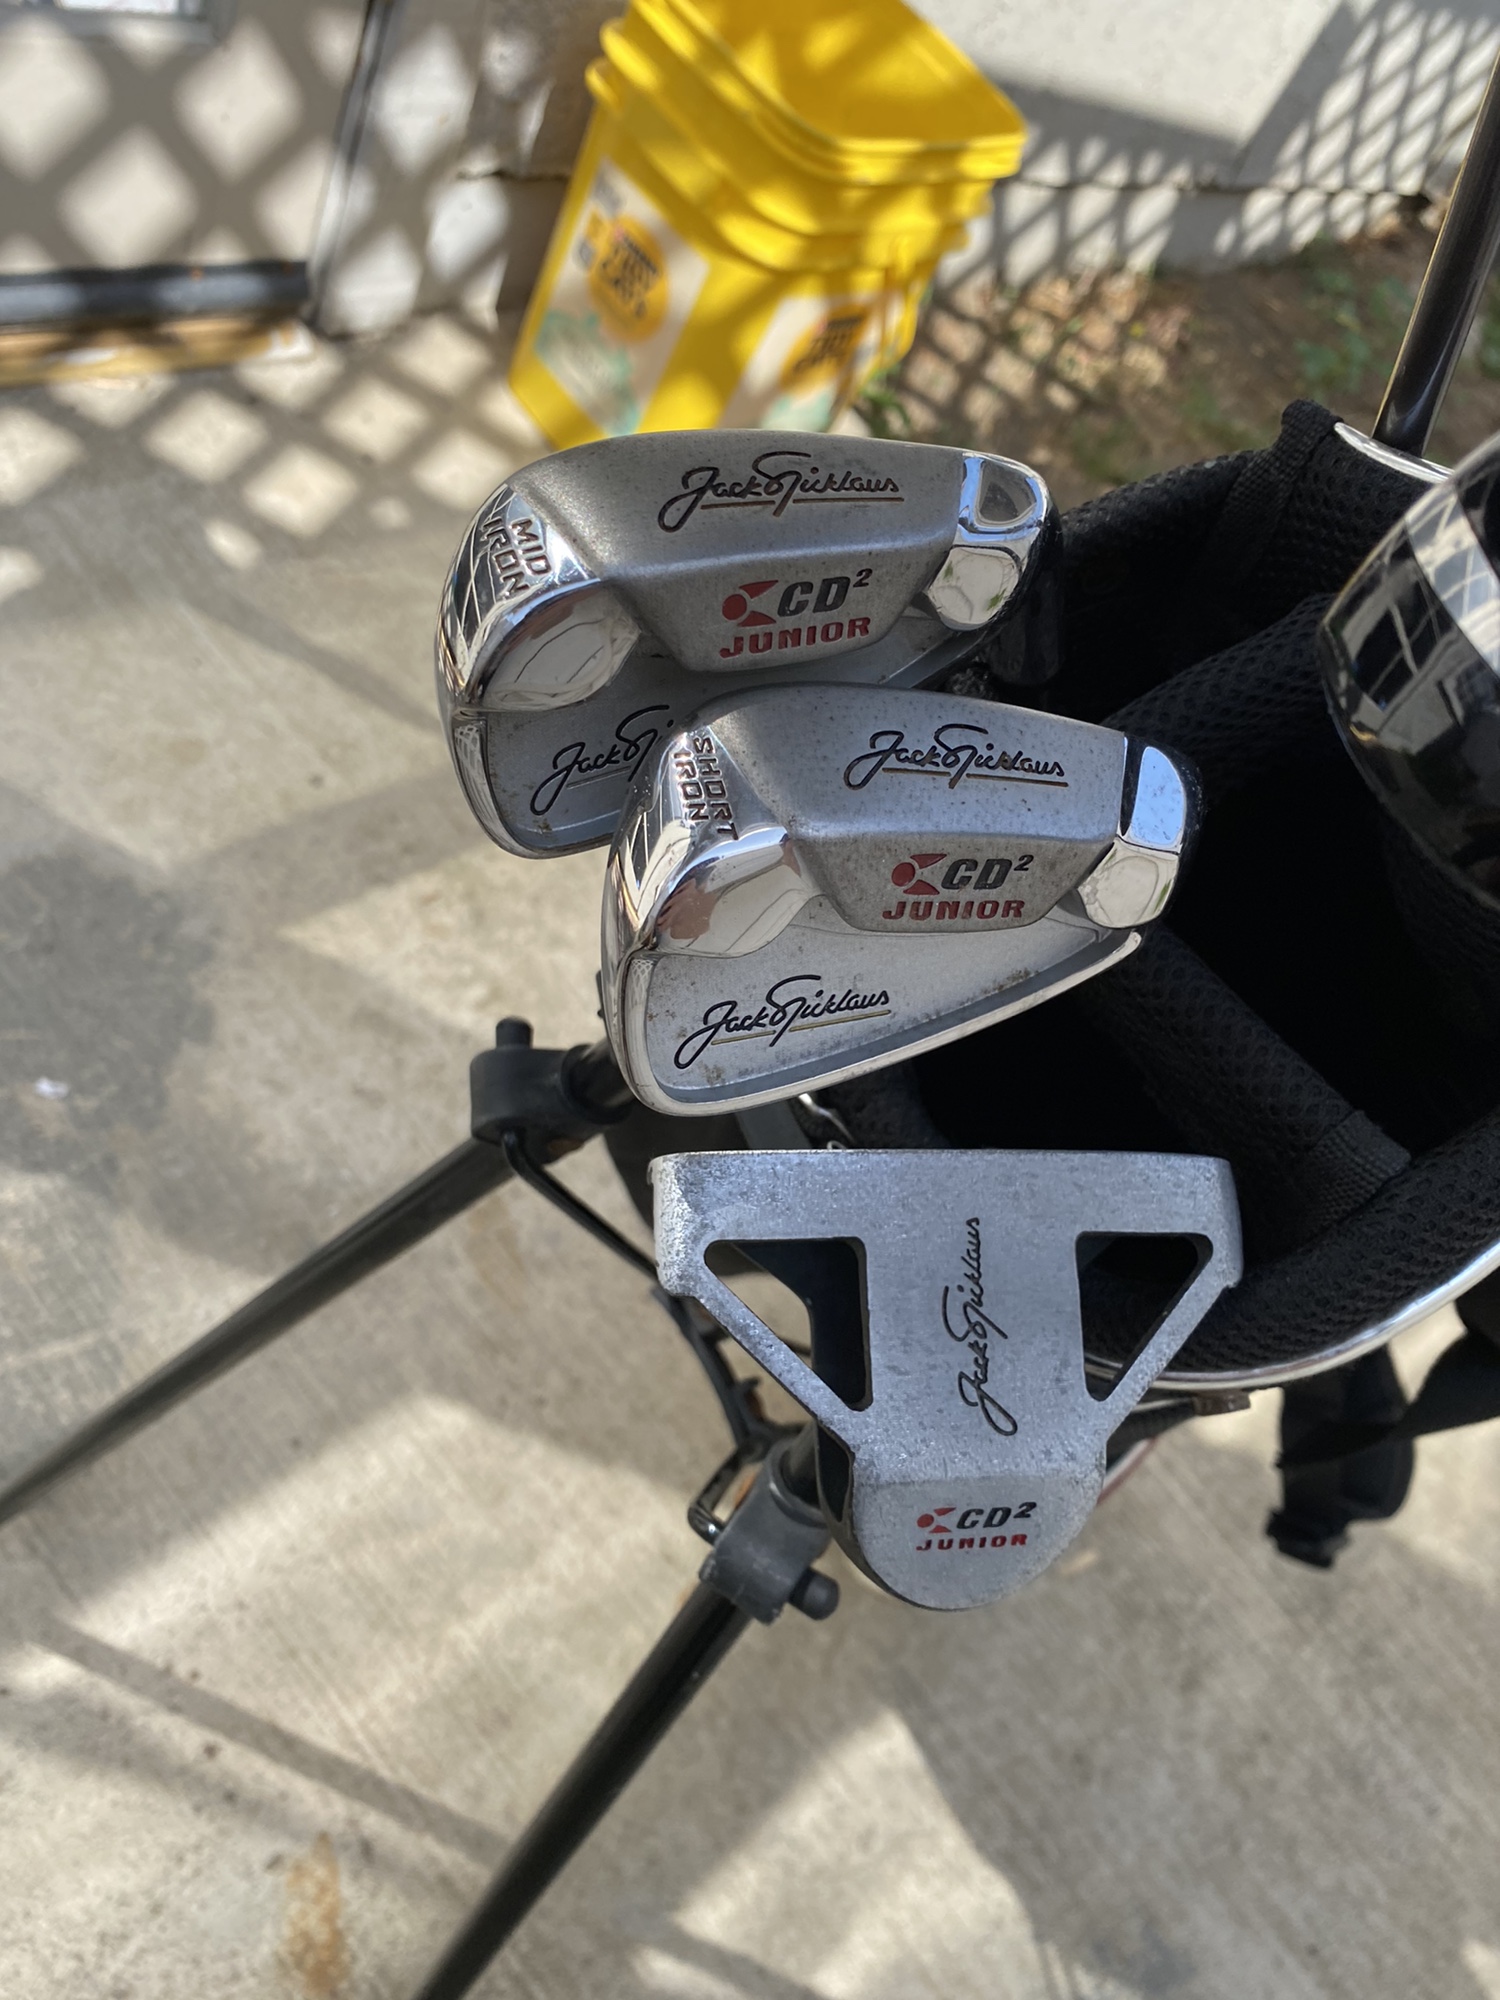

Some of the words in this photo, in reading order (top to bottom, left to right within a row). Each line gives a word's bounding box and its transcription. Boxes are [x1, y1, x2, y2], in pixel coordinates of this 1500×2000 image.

[658, 466, 763, 533] Jack
[480, 517, 530, 598] IRON
[509, 516, 553, 576] MID
[719, 617, 871, 659] JUNIOR
[530, 742, 620, 815] Jack
[673, 751, 710, 822] IRON
[692, 736, 740, 841] SHORT
[844, 730, 940, 790] Jack
[882, 900, 1025, 921] JUNIOR
[674, 1000, 769, 1069] Jack
[958, 1340, 1018, 1437] Jack
[916, 1533, 1028, 1551] JUNIOR
